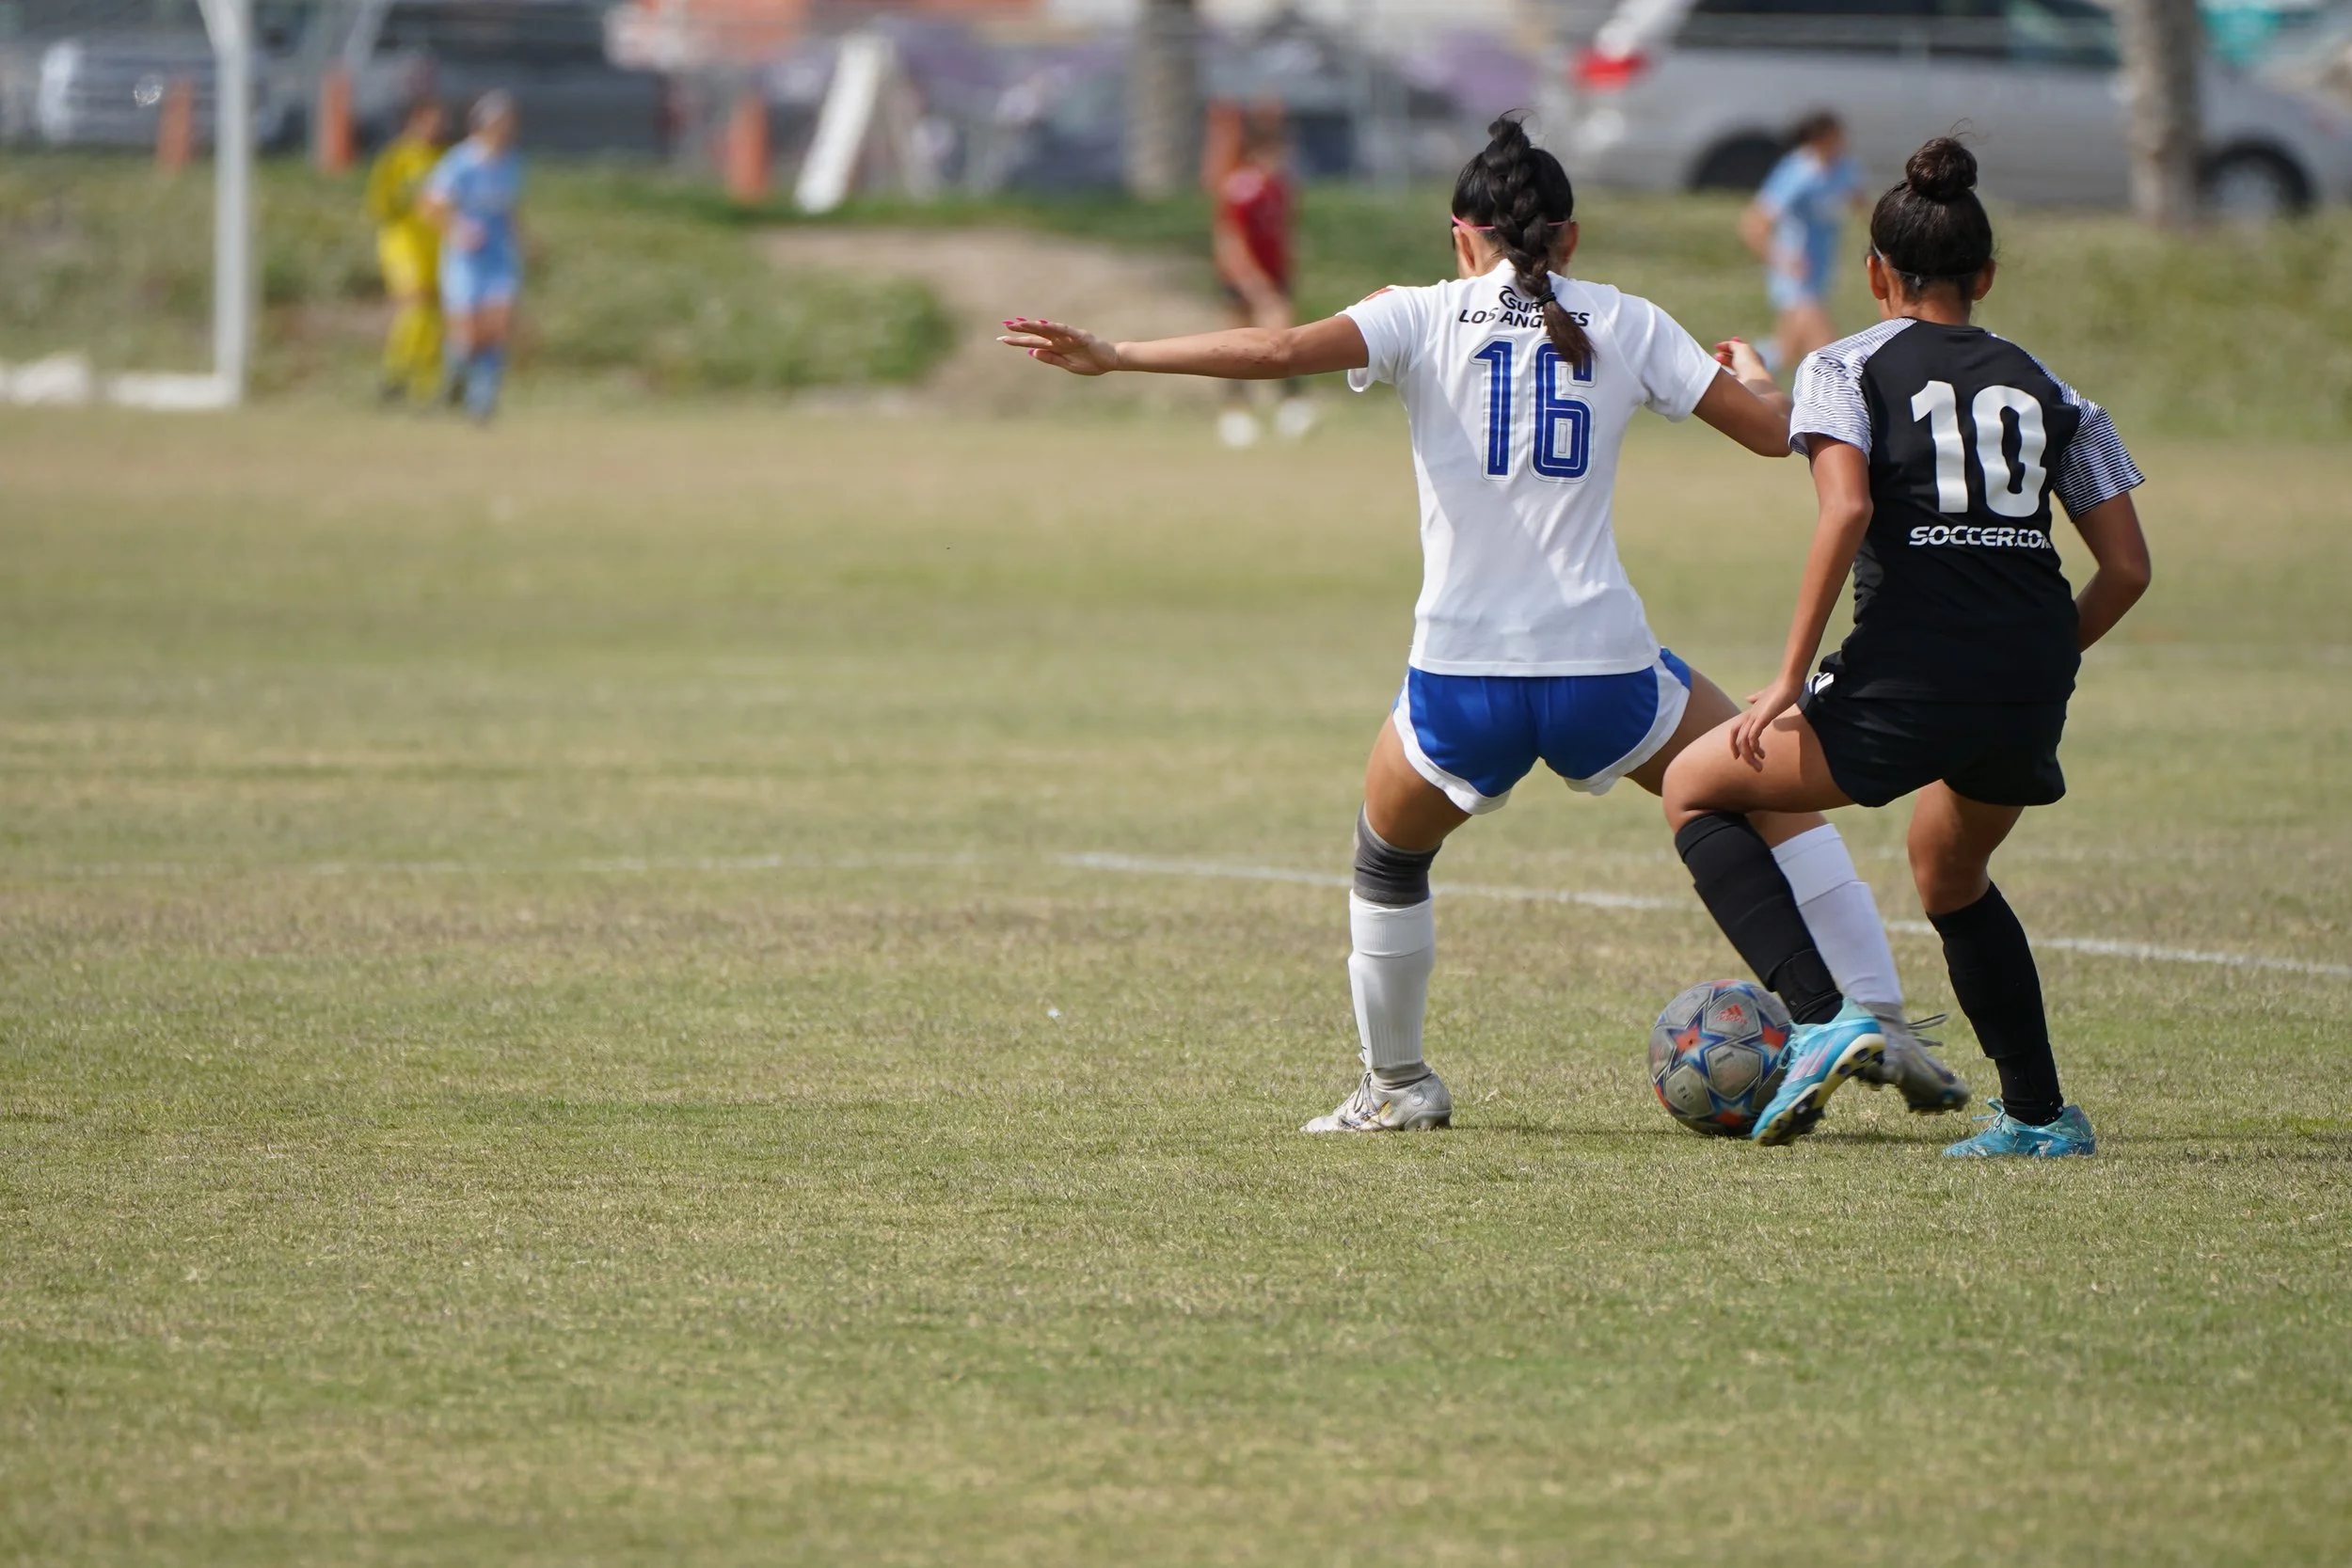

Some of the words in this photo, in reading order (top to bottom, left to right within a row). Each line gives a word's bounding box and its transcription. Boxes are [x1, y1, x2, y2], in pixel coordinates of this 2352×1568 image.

[1459, 308, 1499, 325] LOS
[1500, 310, 1591, 329] ANGS
[1503, 295, 1545, 313] SUR
[1469, 335, 1597, 483] 16
[1911, 380, 2047, 517] 10
